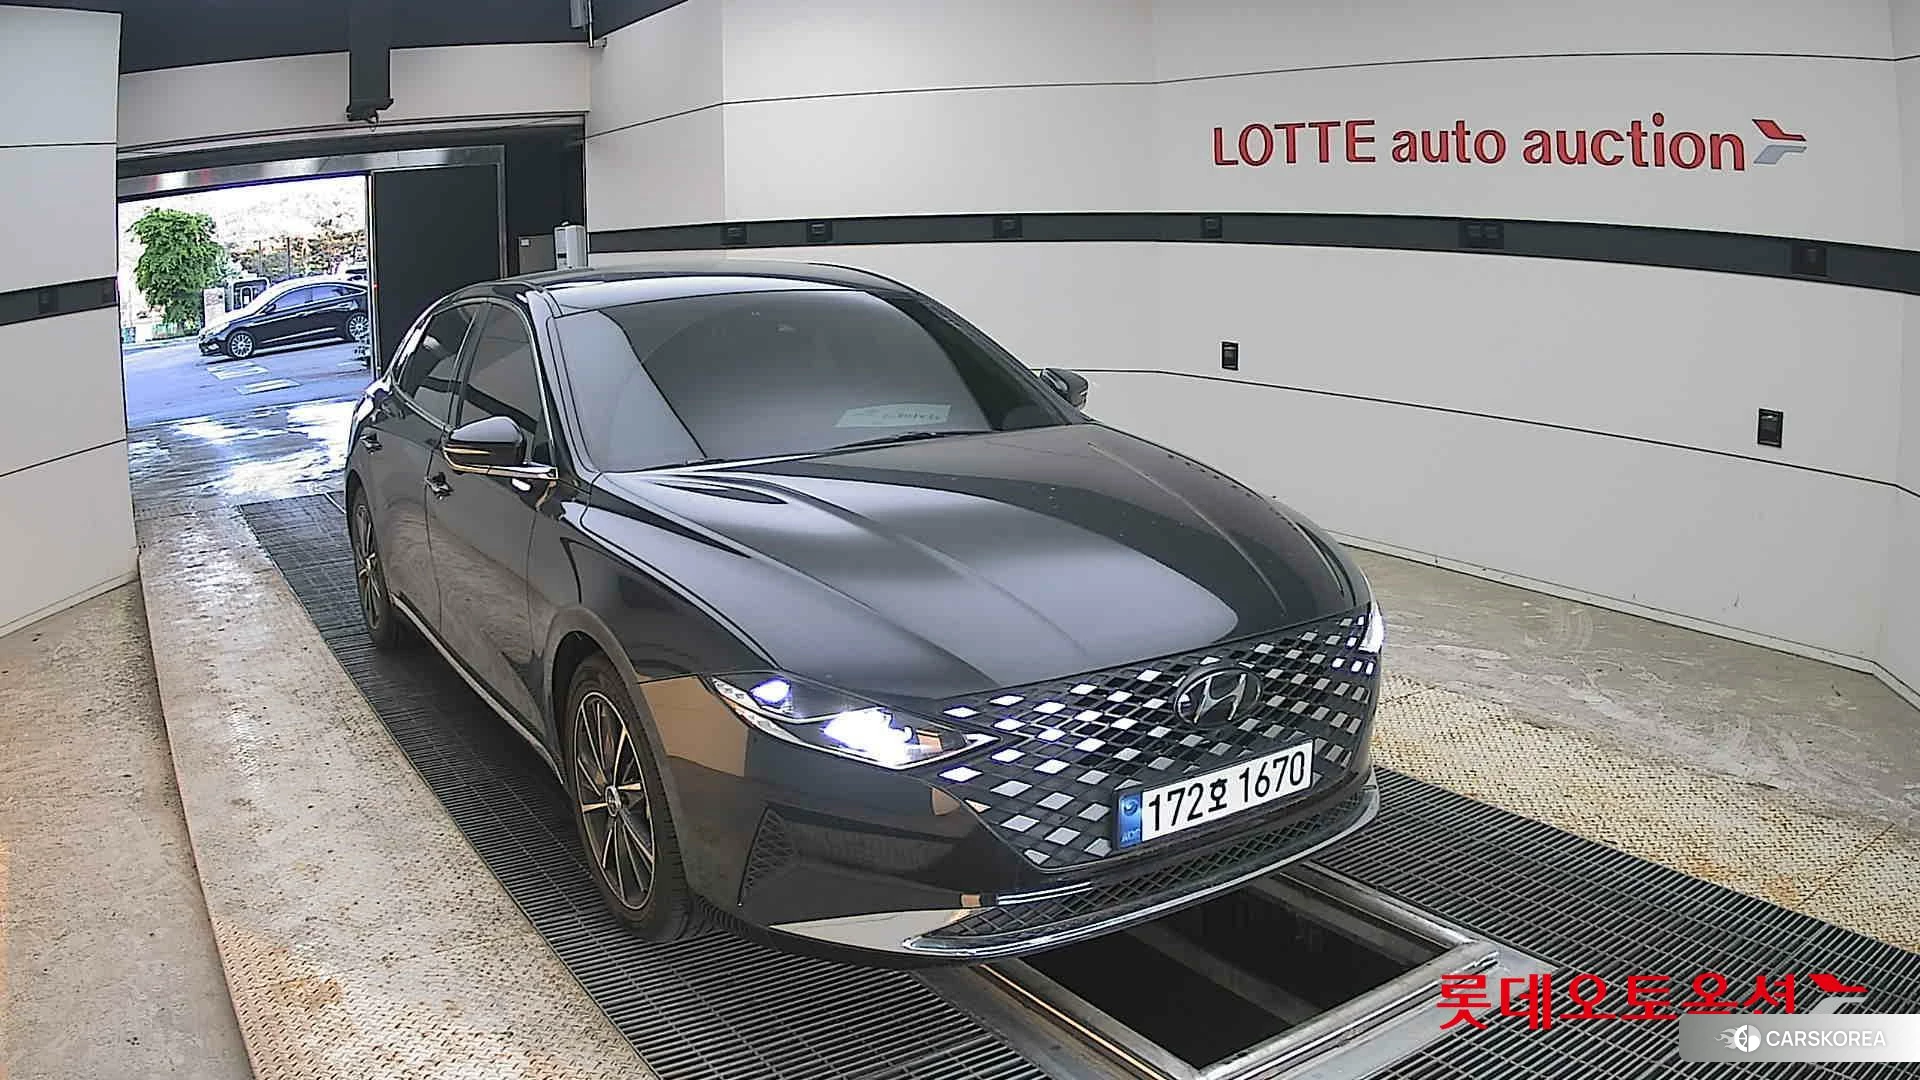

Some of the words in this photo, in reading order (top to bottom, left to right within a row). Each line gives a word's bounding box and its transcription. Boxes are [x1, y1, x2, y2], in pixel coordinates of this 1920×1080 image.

[1213, 119, 1376, 167] LOTTE
[1391, 119, 1507, 165] auto
[1522, 112, 1745, 171] auction
[1148, 777, 1228, 832] 172호
[1238, 750, 1305, 803] 1670
